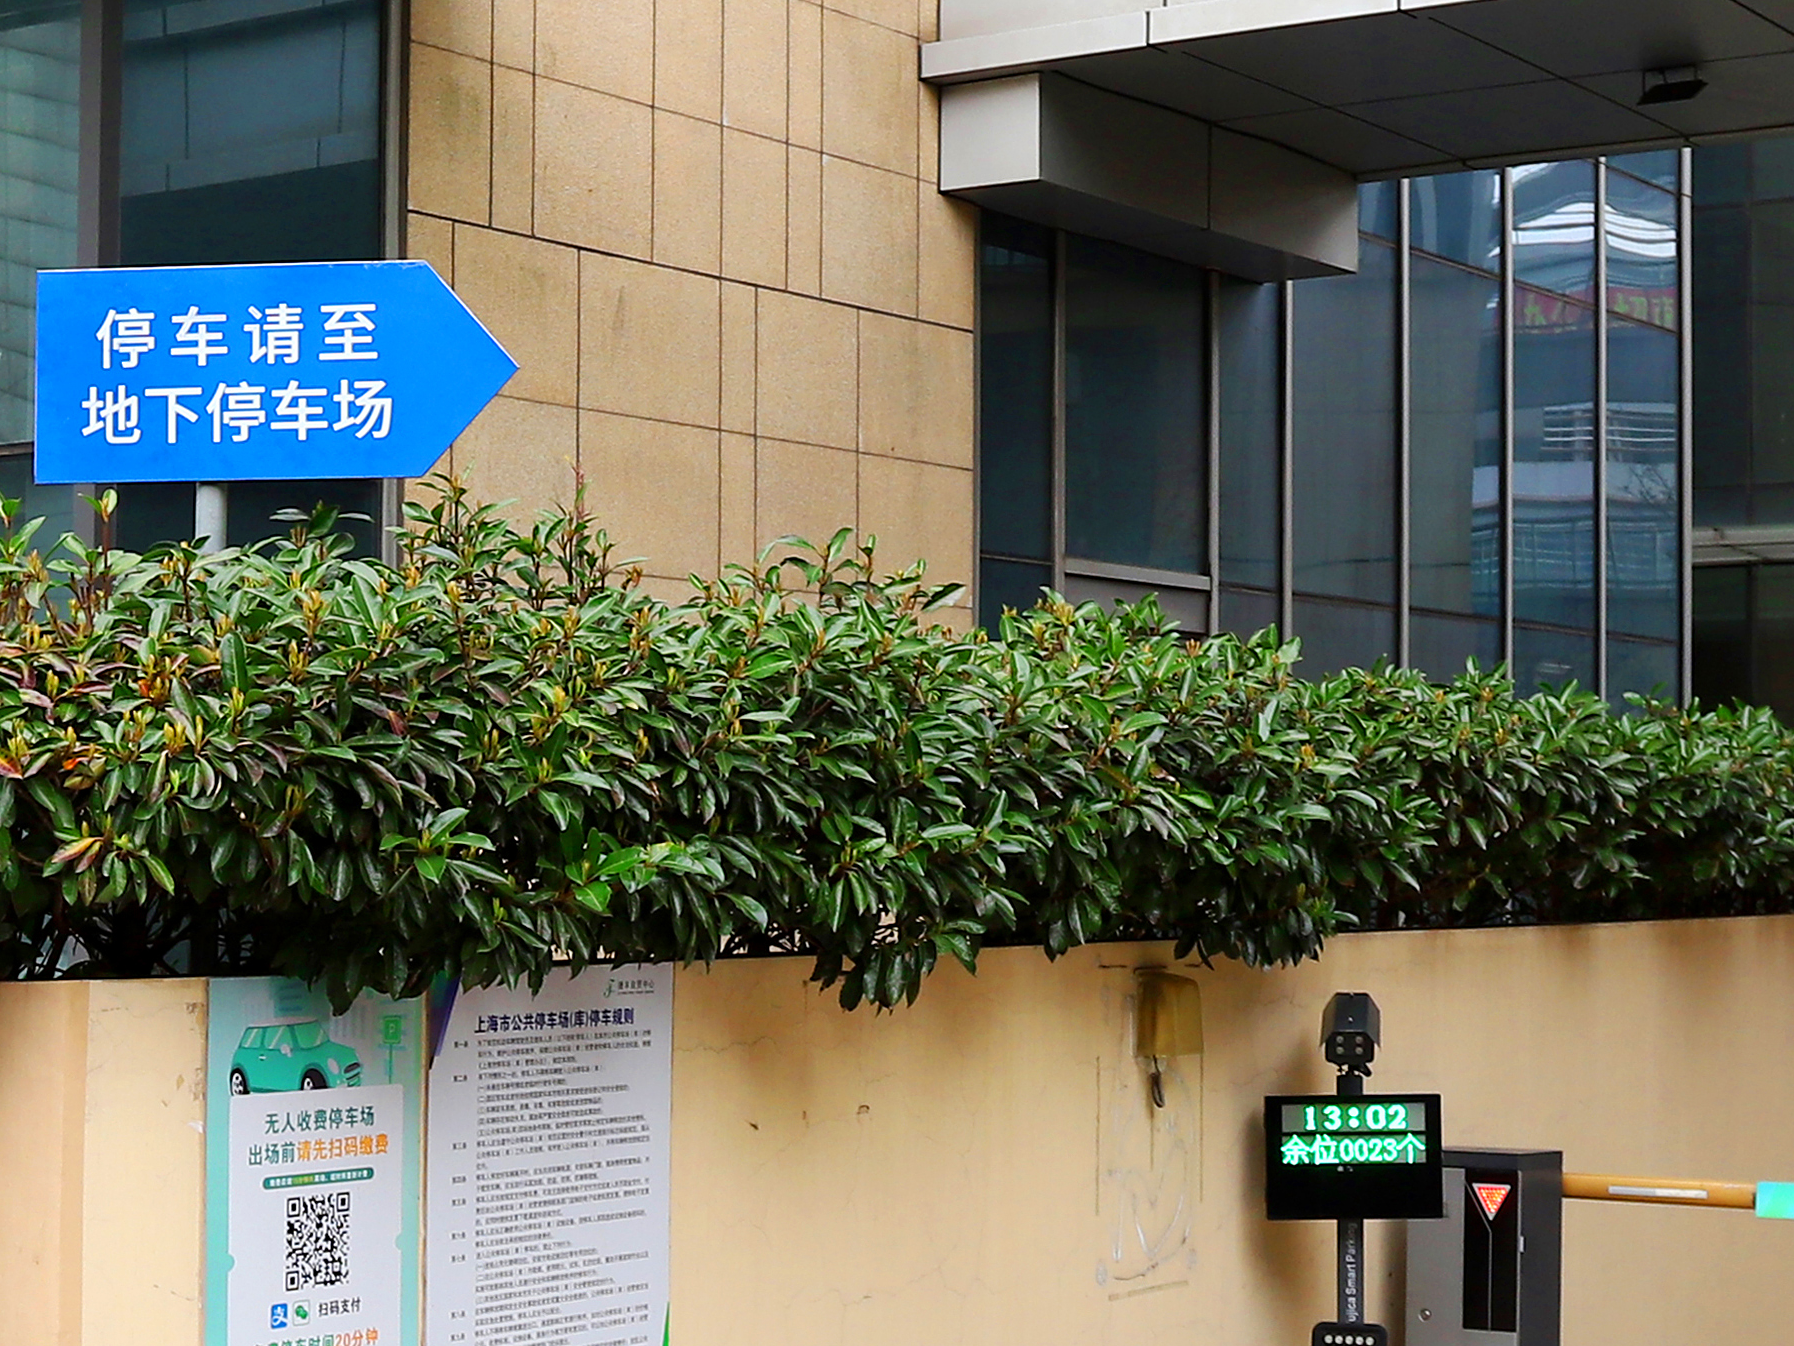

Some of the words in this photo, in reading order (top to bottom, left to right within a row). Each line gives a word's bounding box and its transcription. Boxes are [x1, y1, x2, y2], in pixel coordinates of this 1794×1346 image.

[95, 303, 379, 369] 停车请至
[81, 378, 394, 445] 地下停车场
[474, 1007, 635, 1034] 上海市公共停车场(库)停车规则
[264, 1105, 375, 1134] 无人收费停车场
[1304, 1104, 1407, 1131] 13:02
[248, 1133, 389, 1166] 出场前请先扫码缴费
[1280, 1133, 1426, 1165] 余位0023个
[1345, 1263, 1357, 1295] Smart
[317, 1296, 362, 1317] 扫码支付
[1345, 1295, 1360, 1324] ujica
